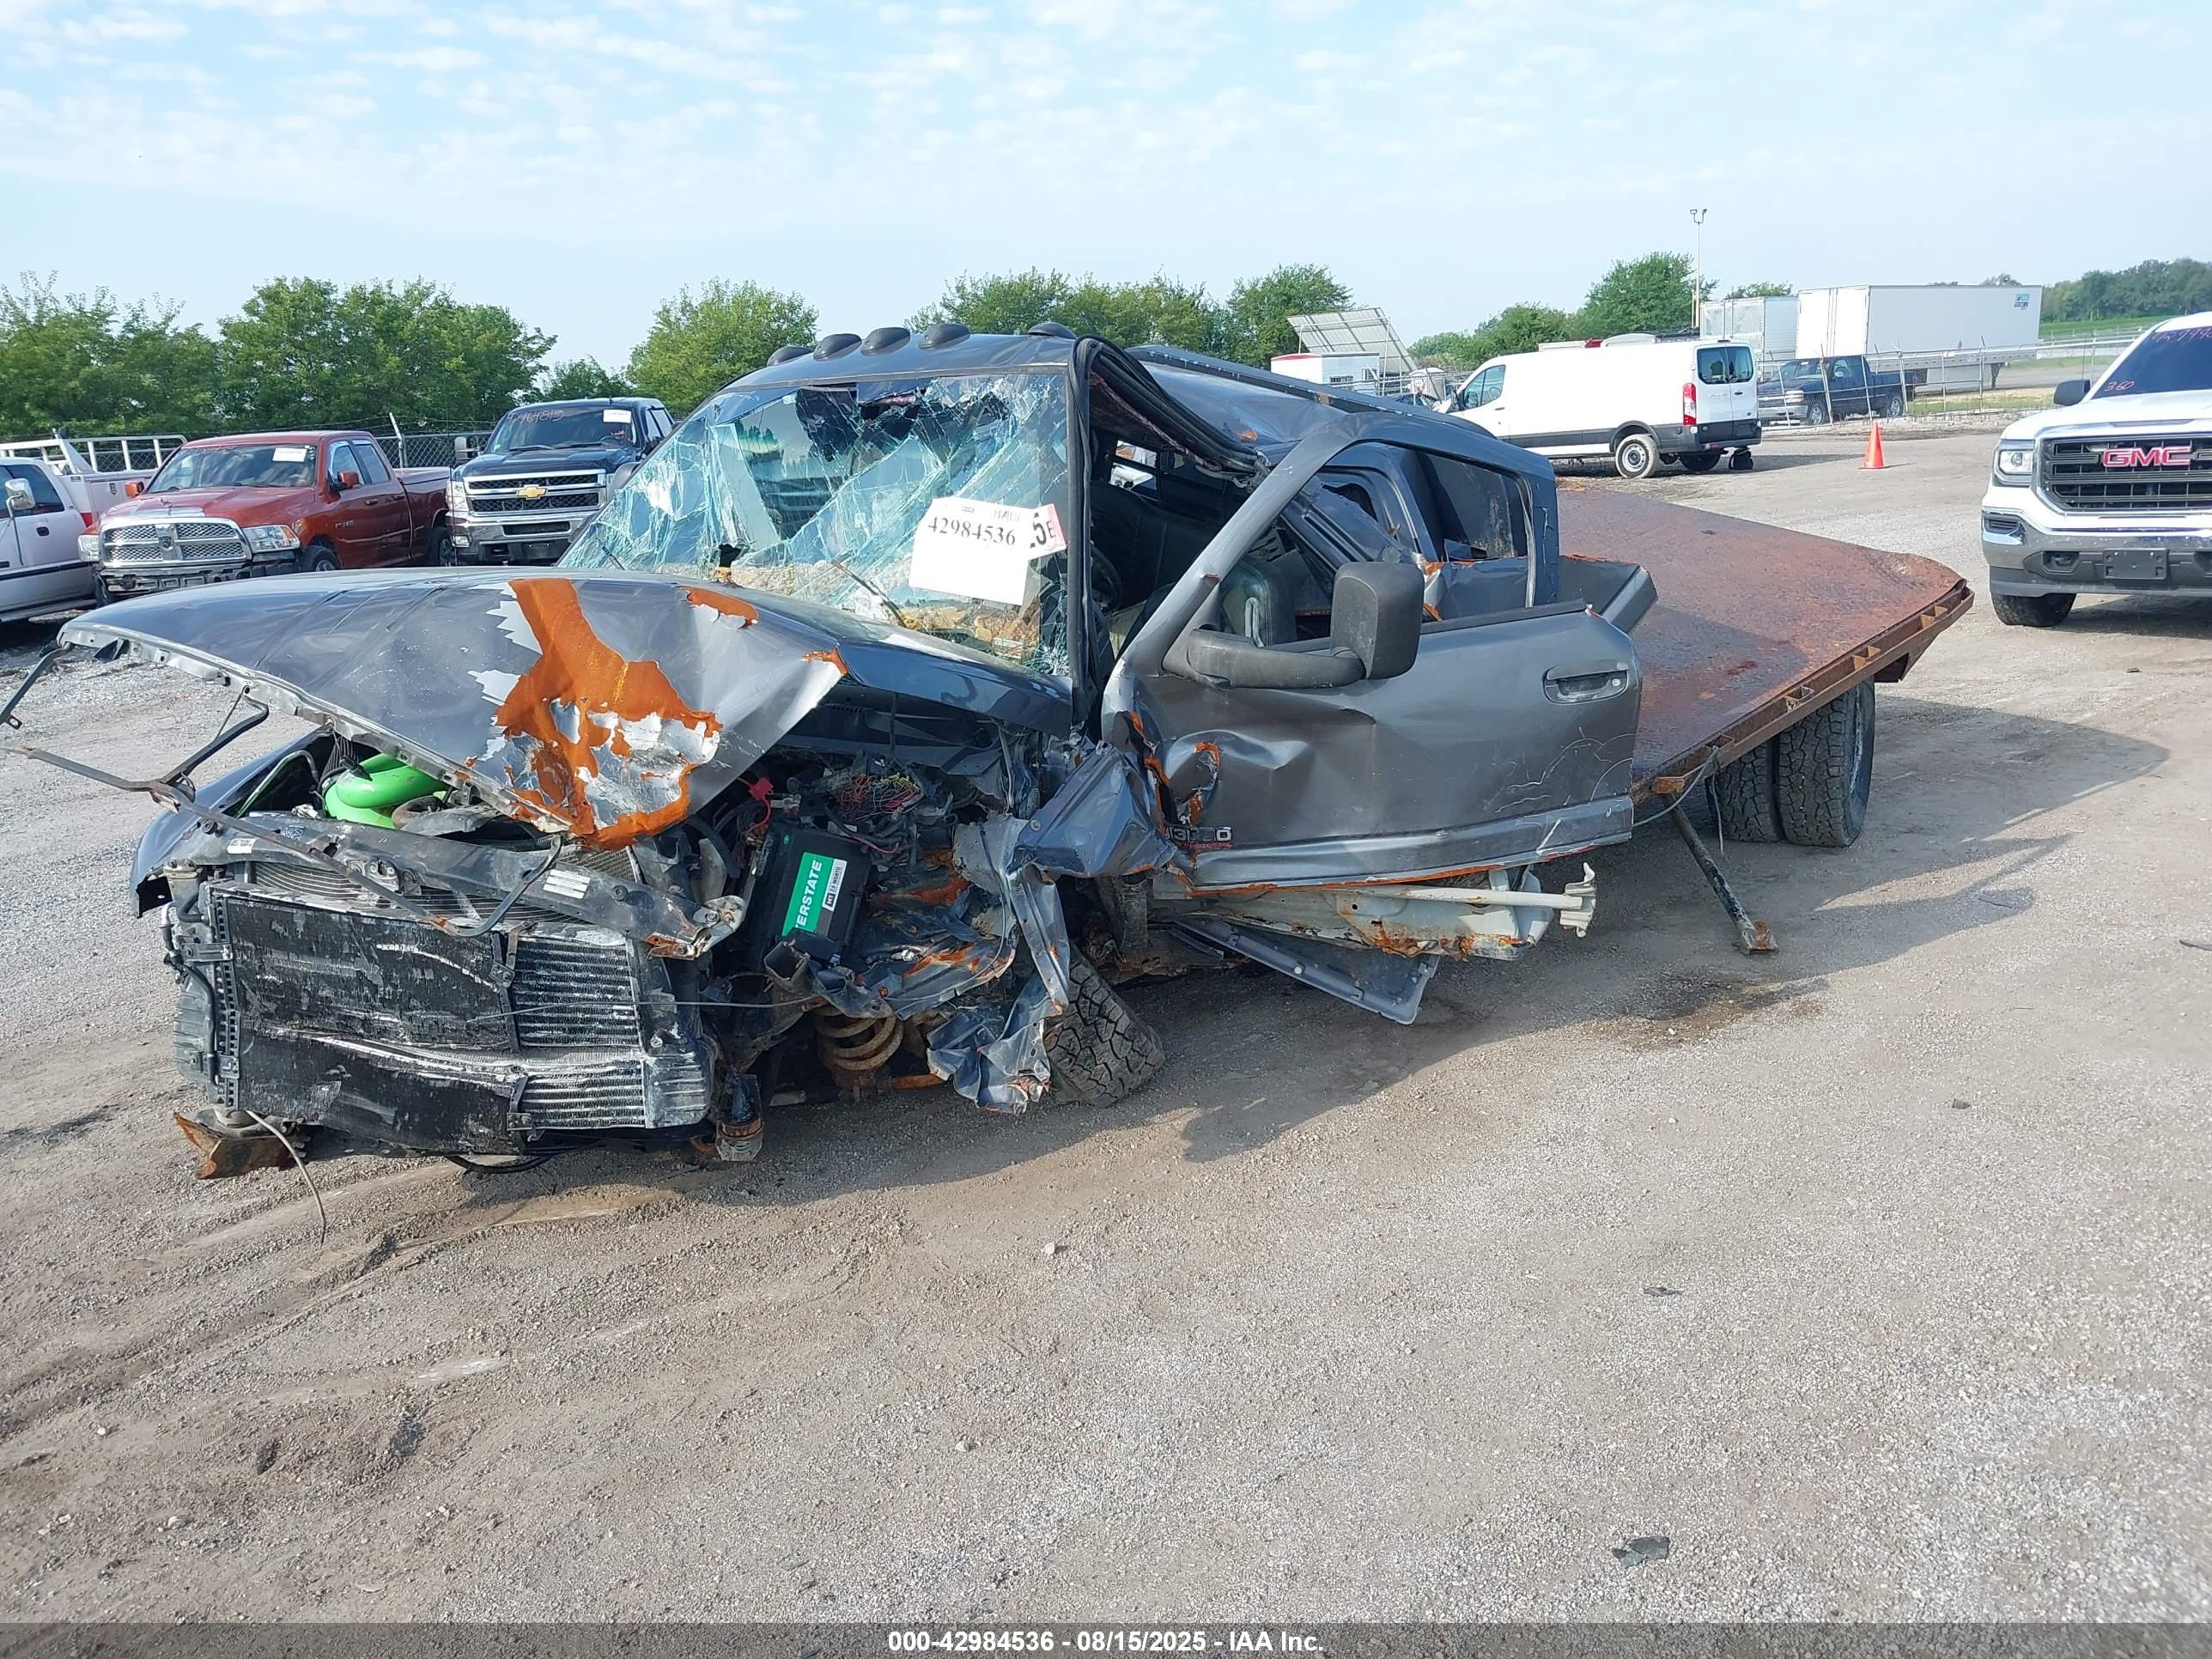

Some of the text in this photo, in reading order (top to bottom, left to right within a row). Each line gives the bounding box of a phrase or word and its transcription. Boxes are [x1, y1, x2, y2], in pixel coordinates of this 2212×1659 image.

[2105, 380, 2135, 392] 360
[2103, 446, 2191, 467] GMC
[927, 516, 1017, 546] 42984536
